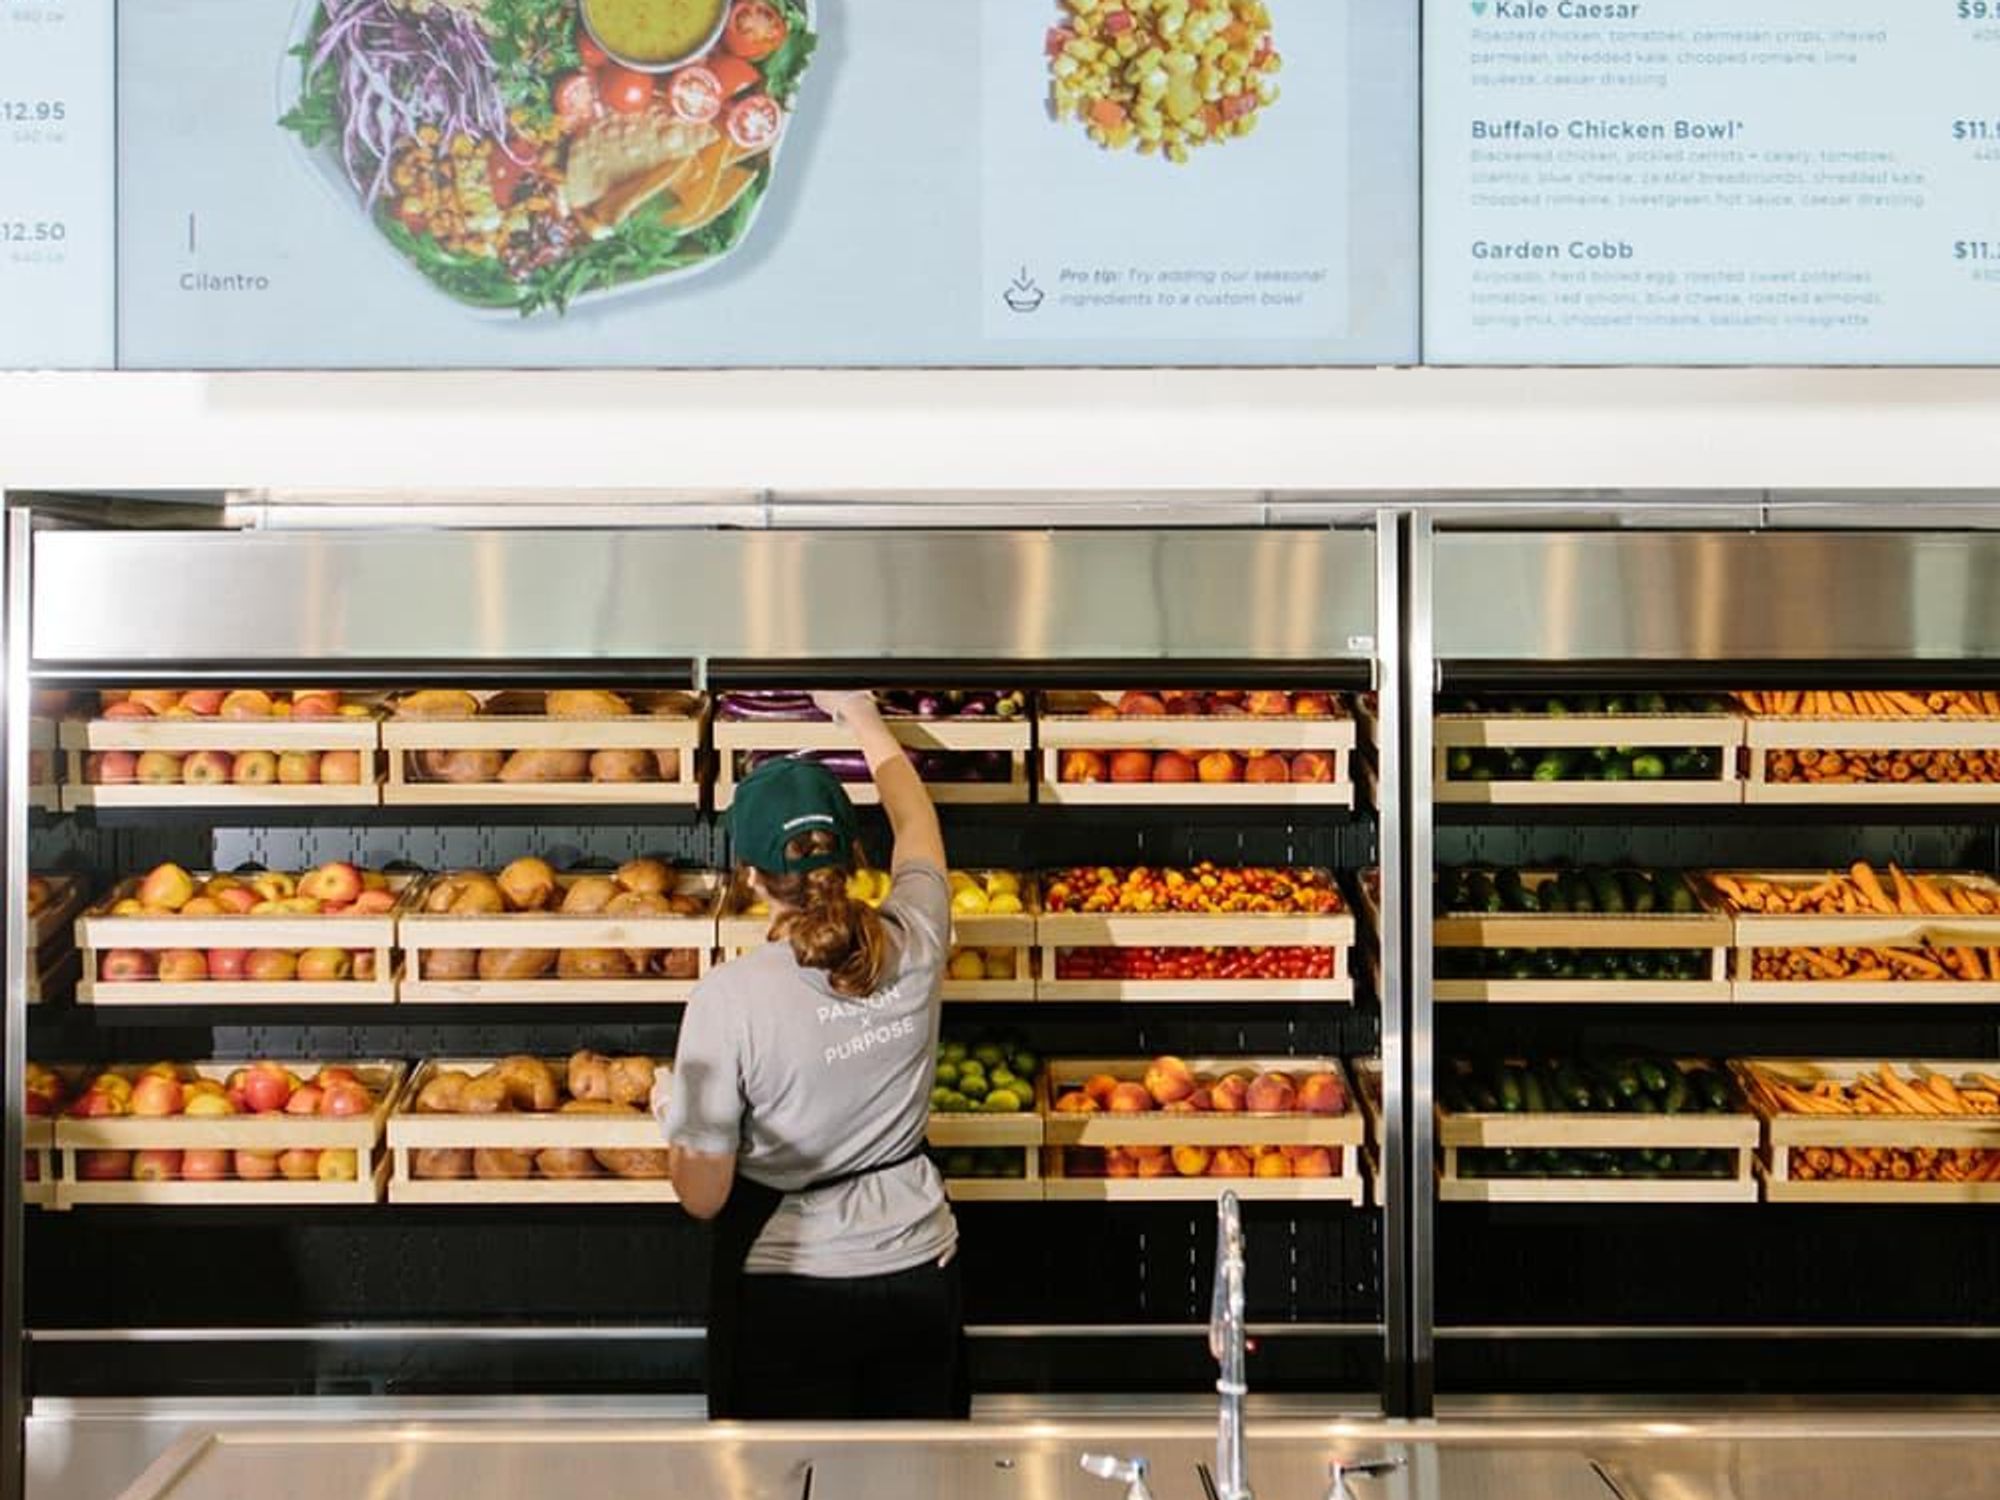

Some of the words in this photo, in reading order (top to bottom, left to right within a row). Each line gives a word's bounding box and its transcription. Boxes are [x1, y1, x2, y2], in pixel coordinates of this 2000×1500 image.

[1496, 0, 1547, 19] Kale
[1557, 0, 1640, 19] Caesar
[1957, 0, 2000, 19] $9.
[0, 101, 65, 121] 12.95
[1472, 120, 1559, 139] Buffalo
[1567, 120, 1665, 139] Chicken
[1952, 120, 2000, 139] $11.
[0, 222, 65, 241] 12.50
[1472, 240, 1560, 259] Garden
[1568, 240, 1633, 259] Cobb
[1952, 240, 2000, 259] $11.
[180, 272, 269, 291] Cilantro
[1060, 267, 1089, 284] Pro
[1128, 267, 1151, 284] Try
[1156, 267, 1217, 284] adding
[1220, 267, 1248, 284] our
[1253, 267, 1327, 284] seasonal
[1059, 292, 1152, 307] ingredients
[1157, 292, 1175, 307] to
[1180, 292, 1191, 307] a
[1194, 292, 1256, 307] custom
[815, 986, 901, 1025] PASON
[824, 1015, 915, 1066] PURPOSE
